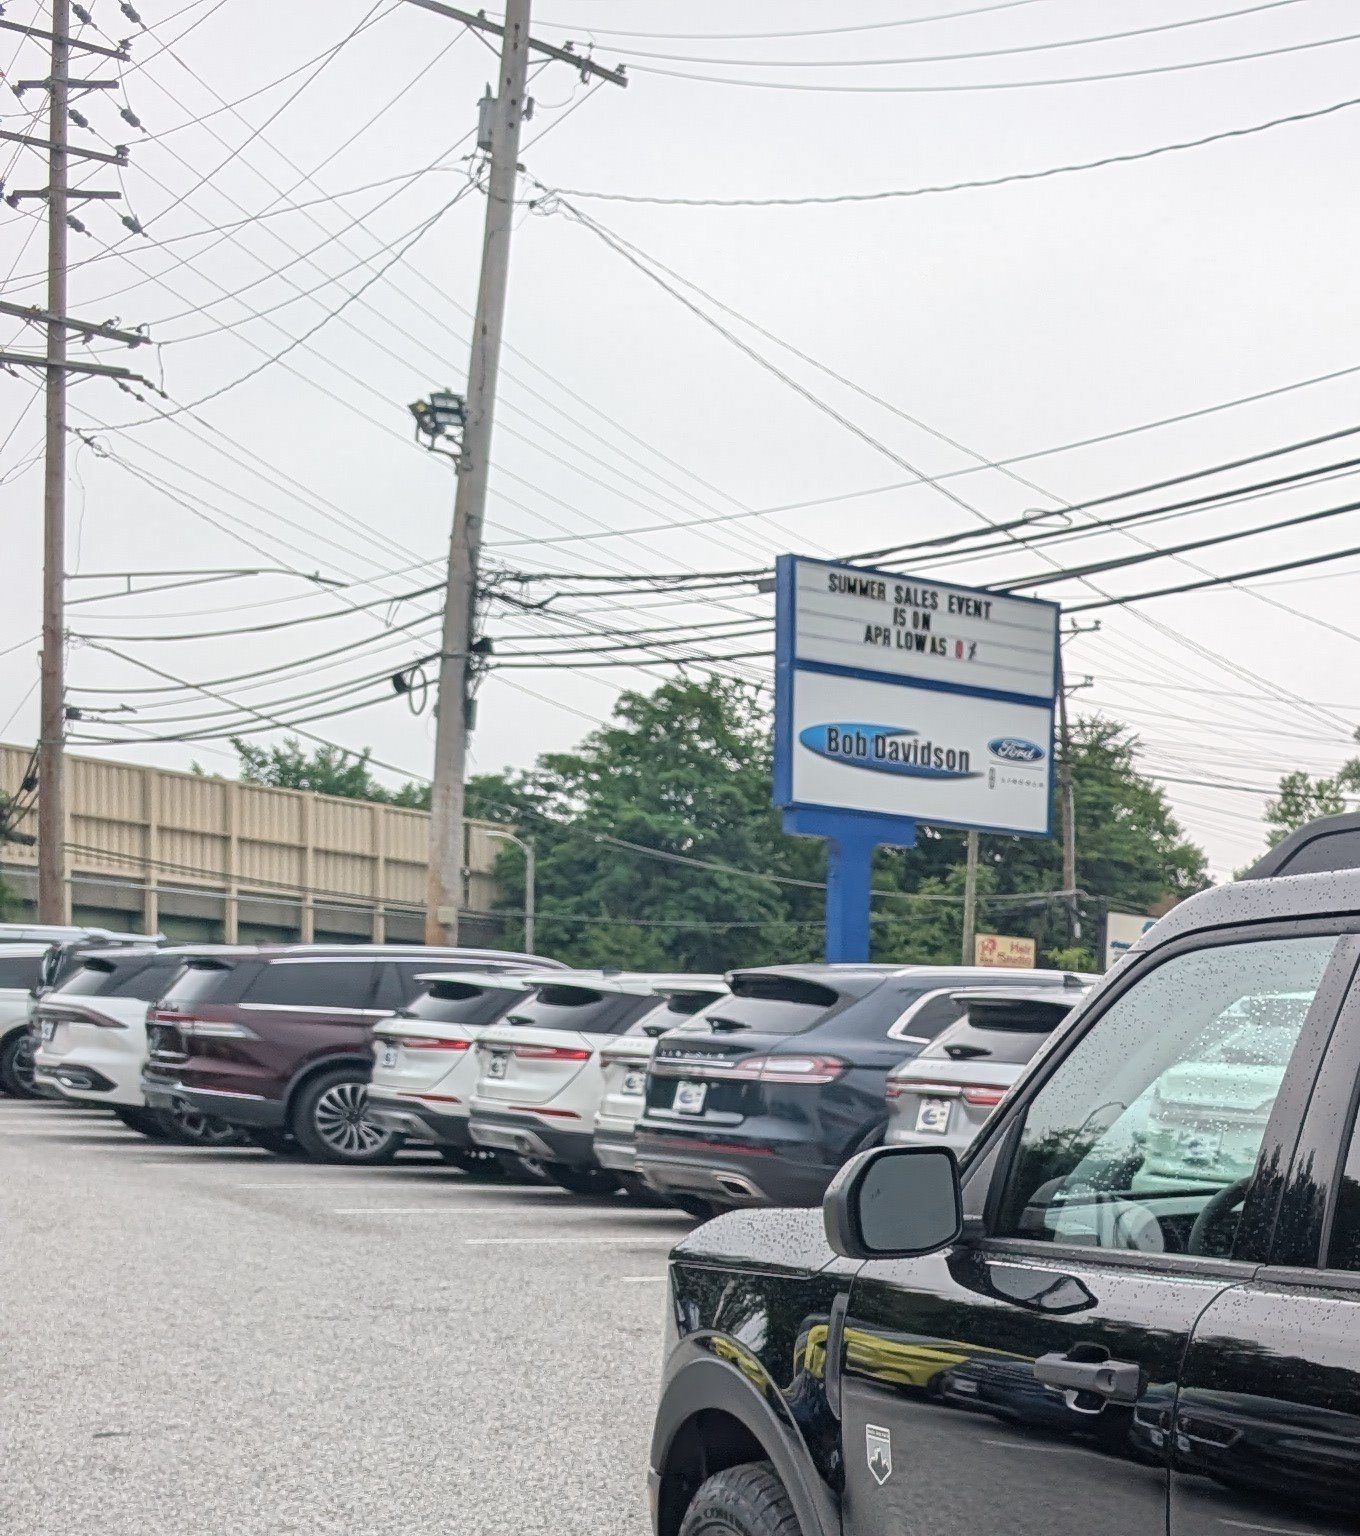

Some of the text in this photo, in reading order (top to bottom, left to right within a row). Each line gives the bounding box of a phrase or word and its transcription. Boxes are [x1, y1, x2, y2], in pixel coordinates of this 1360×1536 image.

[828, 573, 993, 621] SUMMER SALES EVENT
[893, 607, 931, 631] IS ON
[864, 624, 891, 647] APR
[896, 630, 927, 653] LOW
[930, 636, 947, 657] AS
[827, 726, 970, 773] Bob Davidson
